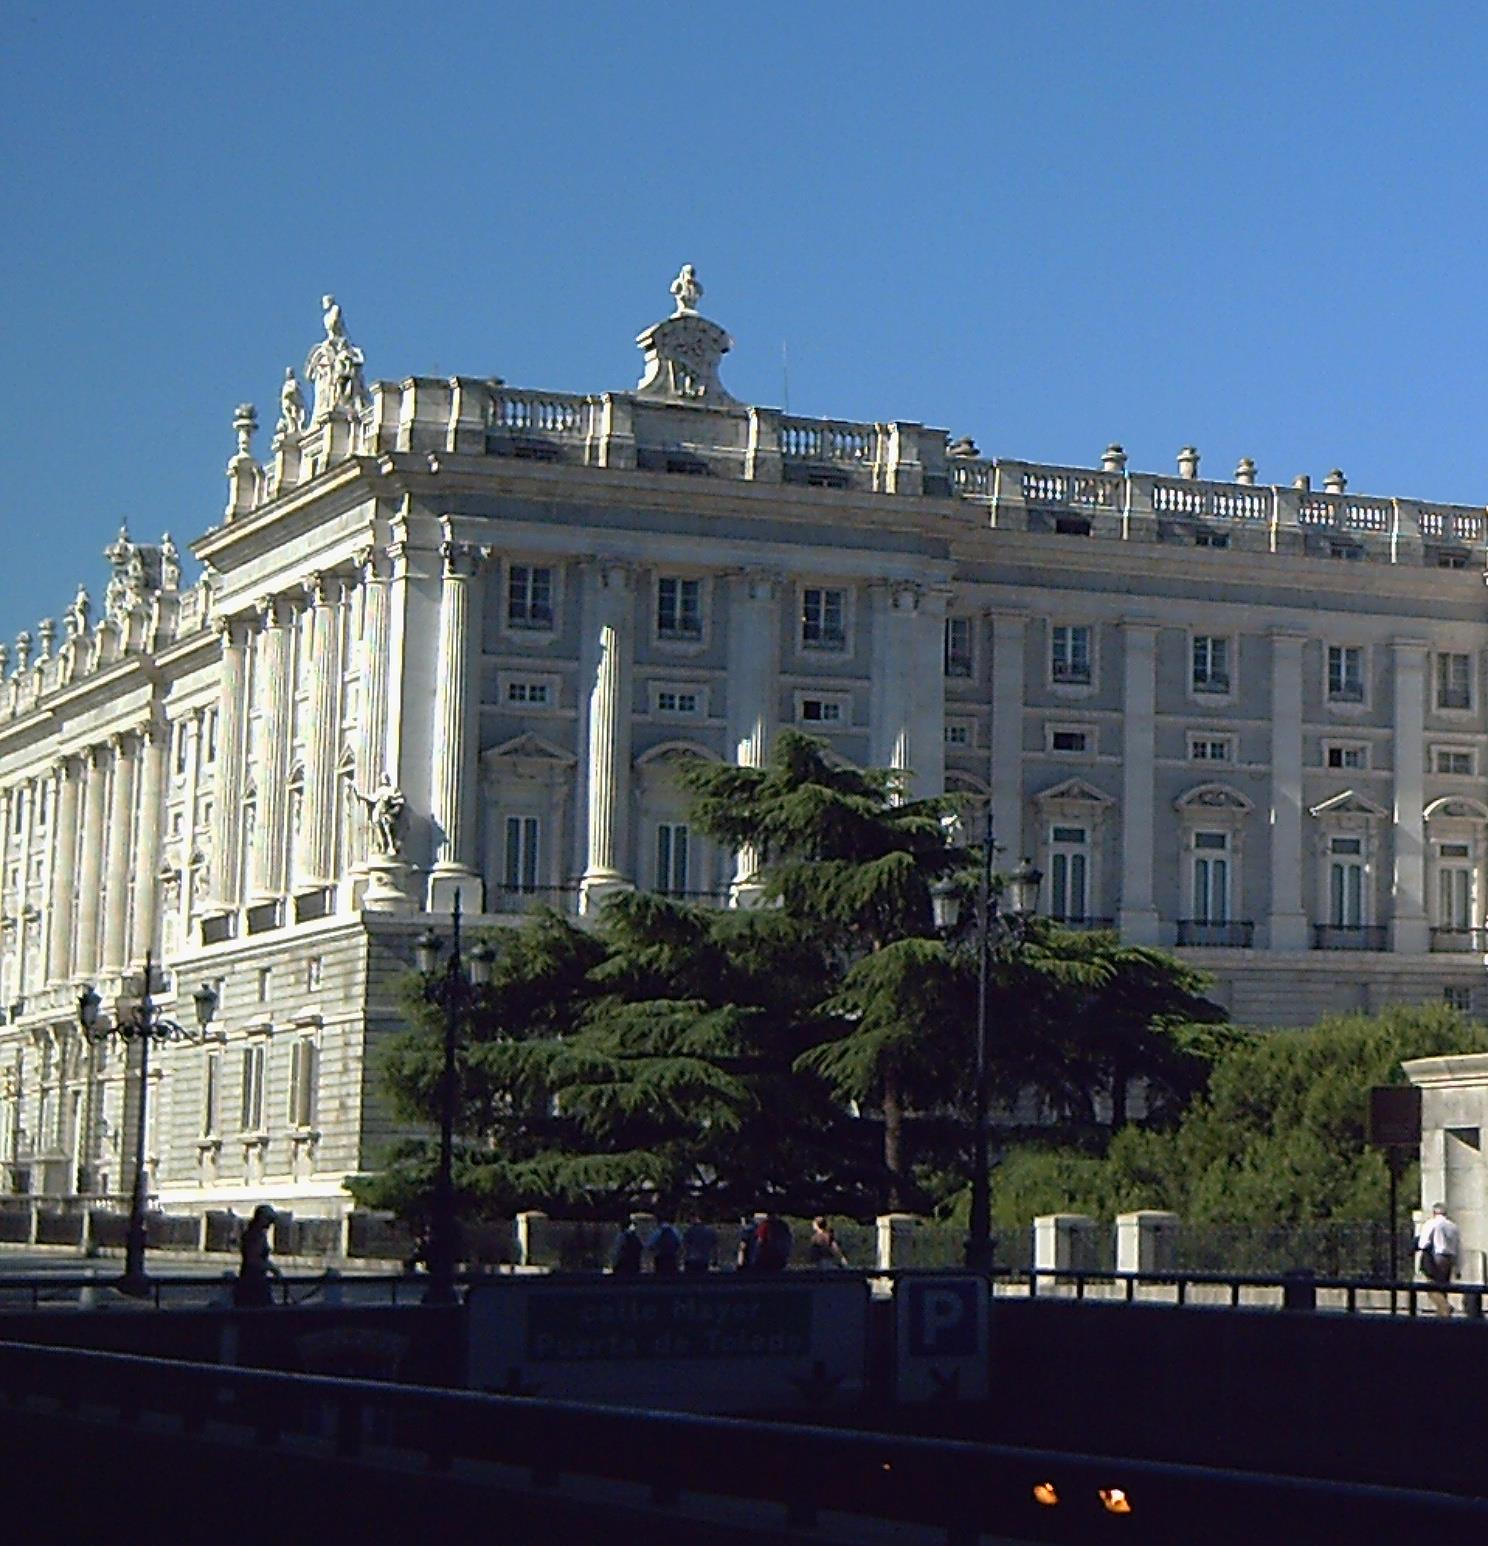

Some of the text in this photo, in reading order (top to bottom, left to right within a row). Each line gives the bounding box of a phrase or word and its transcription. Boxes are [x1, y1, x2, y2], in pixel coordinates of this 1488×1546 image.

[580, 1297, 760, 1324] calle Mayor
[922, 1289, 963, 1345] P
[535, 1329, 802, 1357] Puerta de Toledo
